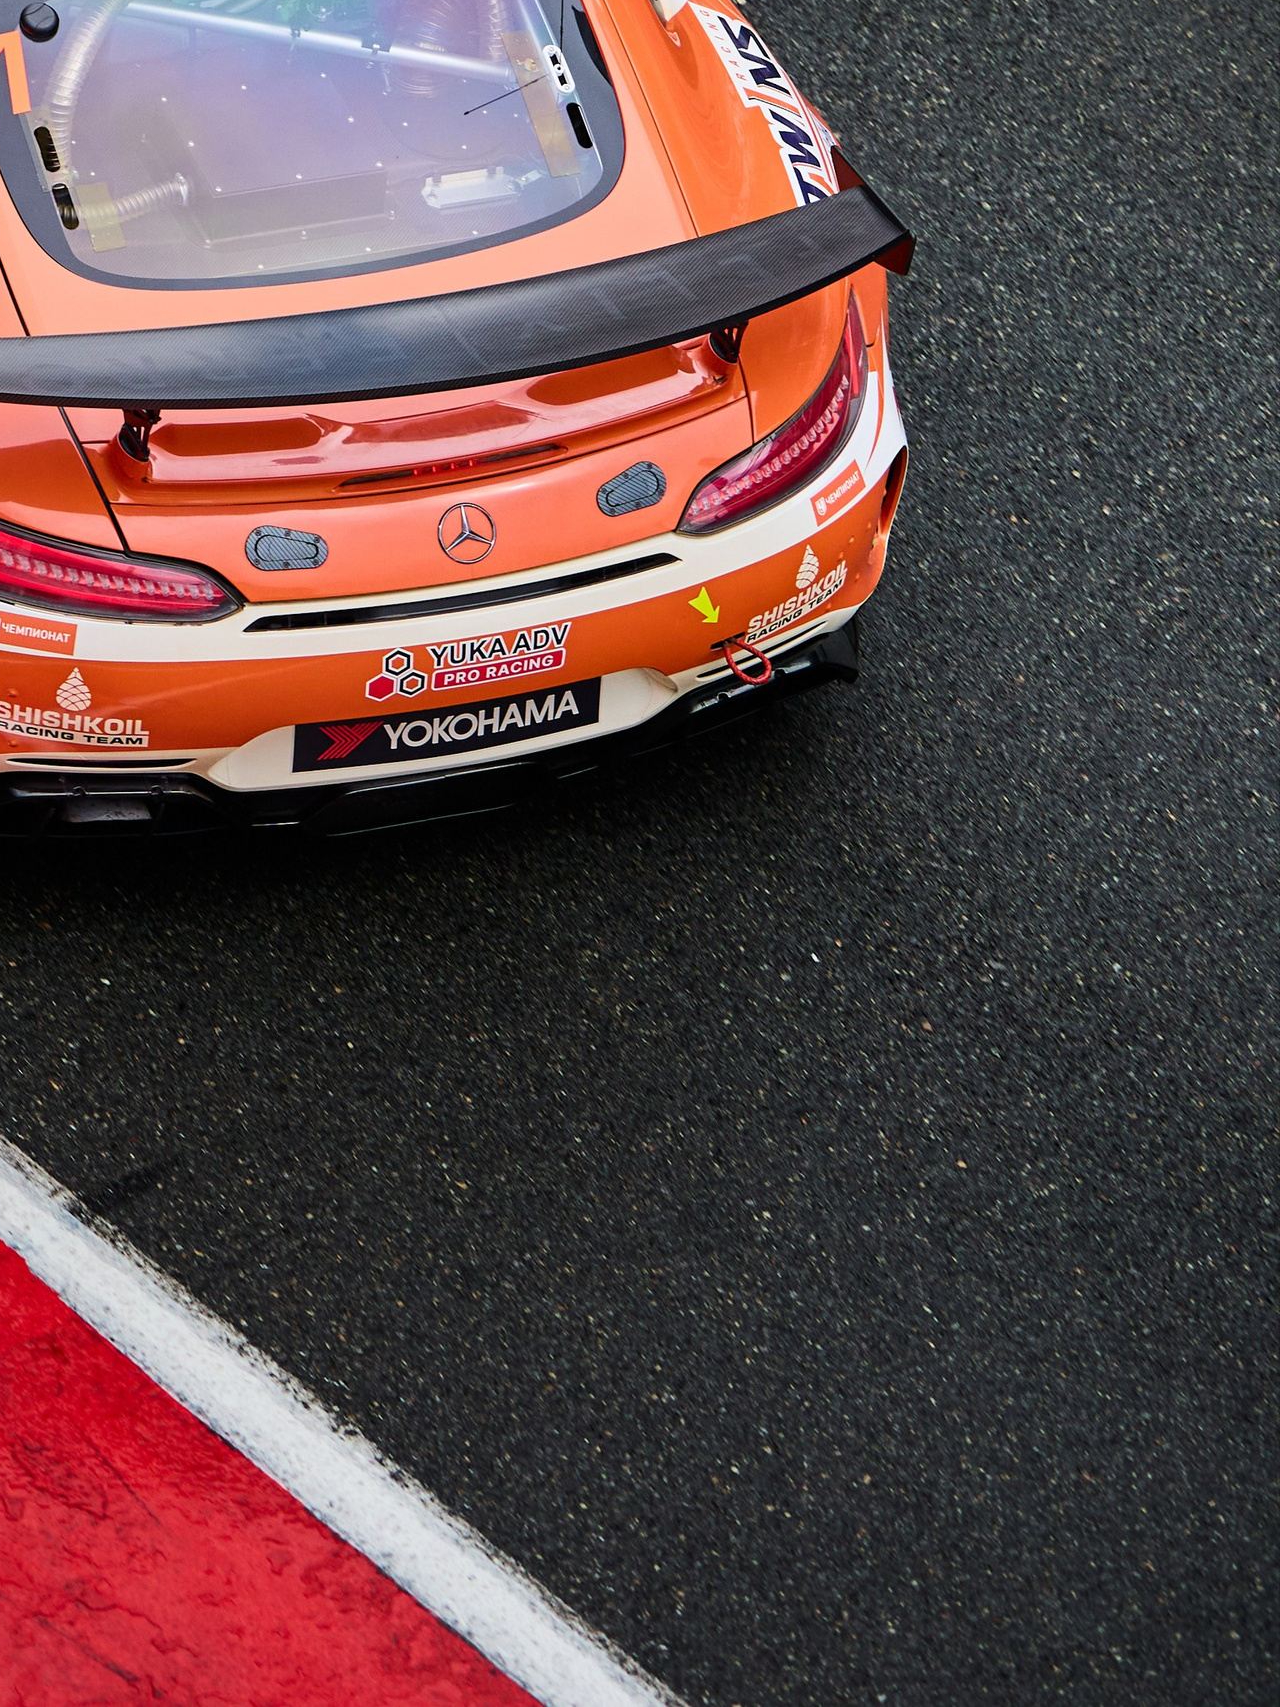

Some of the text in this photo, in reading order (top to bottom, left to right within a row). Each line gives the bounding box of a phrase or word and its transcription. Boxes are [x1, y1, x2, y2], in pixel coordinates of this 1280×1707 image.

[699, 9, 747, 82] RACING
[747, 560, 848, 634] SHISHKOIL
[747, 578, 843, 643] RACING TEAM
[1, 623, 71, 643] ЧЕМПИОНАТ
[429, 624, 569, 668] YUKA ADV
[443, 655, 554, 686] PRO RACING
[83, 734, 143, 746] TEAM
[383, 690, 579, 749] YOKOHAMA
